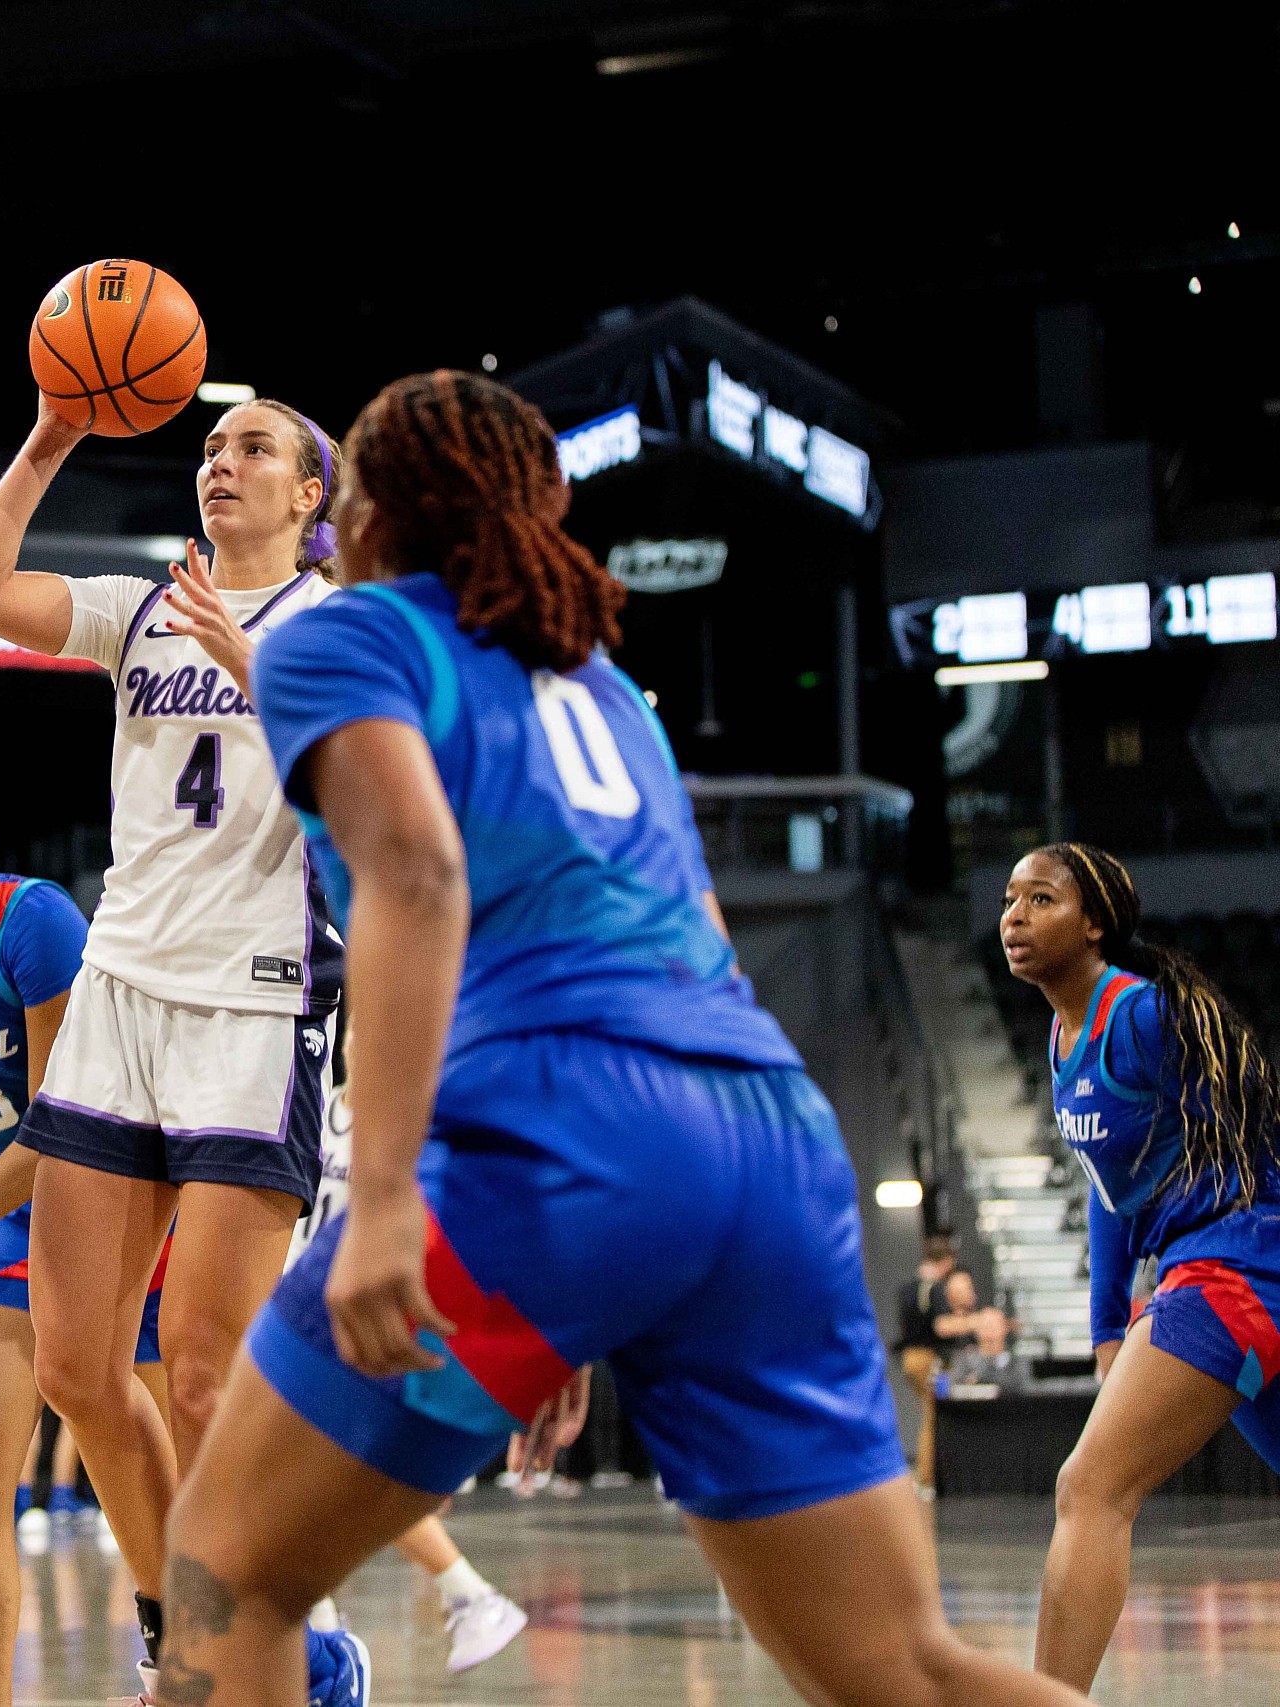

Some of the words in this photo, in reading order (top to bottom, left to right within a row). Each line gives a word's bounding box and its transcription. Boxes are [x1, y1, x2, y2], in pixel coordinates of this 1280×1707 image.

[96, 258, 131, 303] ELIT
[558, 410, 641, 483] PORTS
[126, 664, 258, 718] Wildca
[531, 669, 641, 820] 0
[175, 732, 225, 829] 4
[287, 966, 297, 978] M
